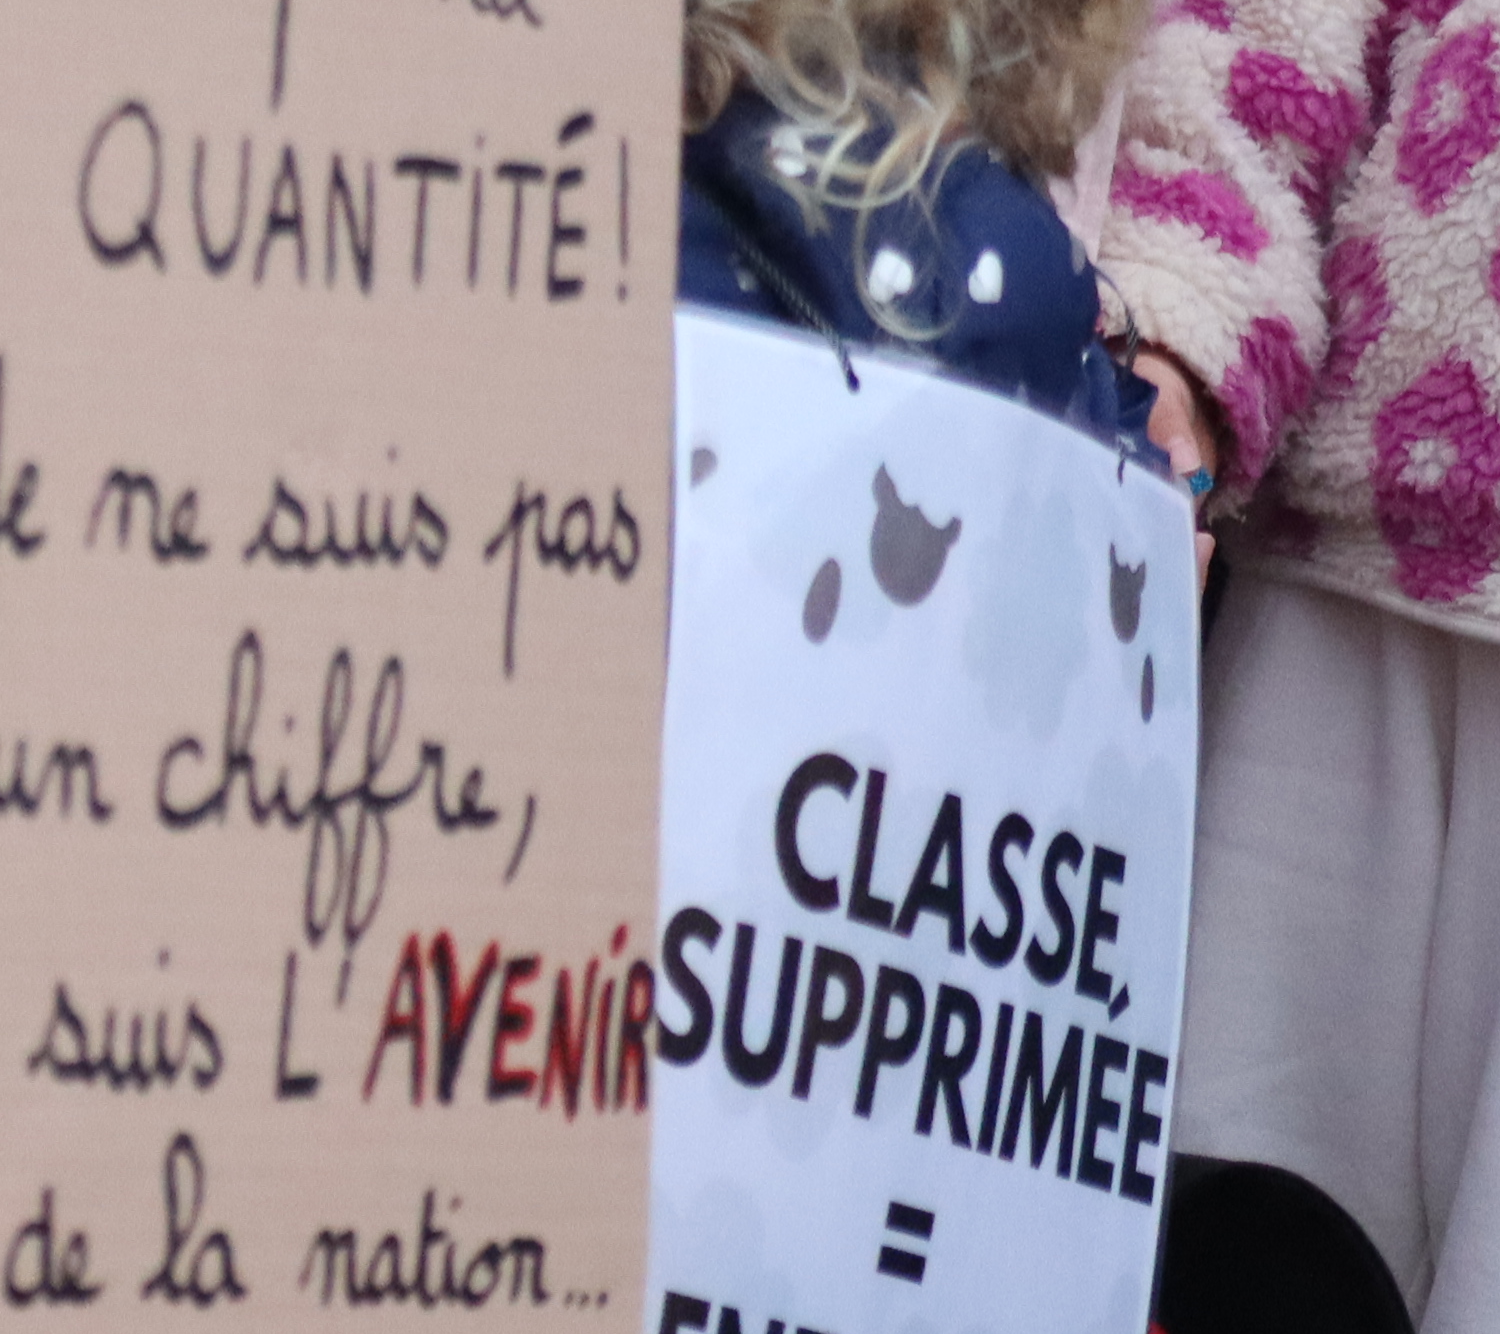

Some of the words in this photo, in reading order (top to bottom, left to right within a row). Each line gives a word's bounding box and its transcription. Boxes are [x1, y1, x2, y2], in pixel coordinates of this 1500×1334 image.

[85, 465, 206, 562] ne
[241, 446, 449, 568] suis
[484, 477, 642, 679] pas
[154, 628, 538, 948] chiffre,
[775, 752, 1126, 1005] CLASSE
[27, 949, 225, 1090] suis
[655, 905, 1169, 1205] SUPPRIMÉE
[2, 1185, 103, 1307] de
[140, 1131, 249, 1305] la
